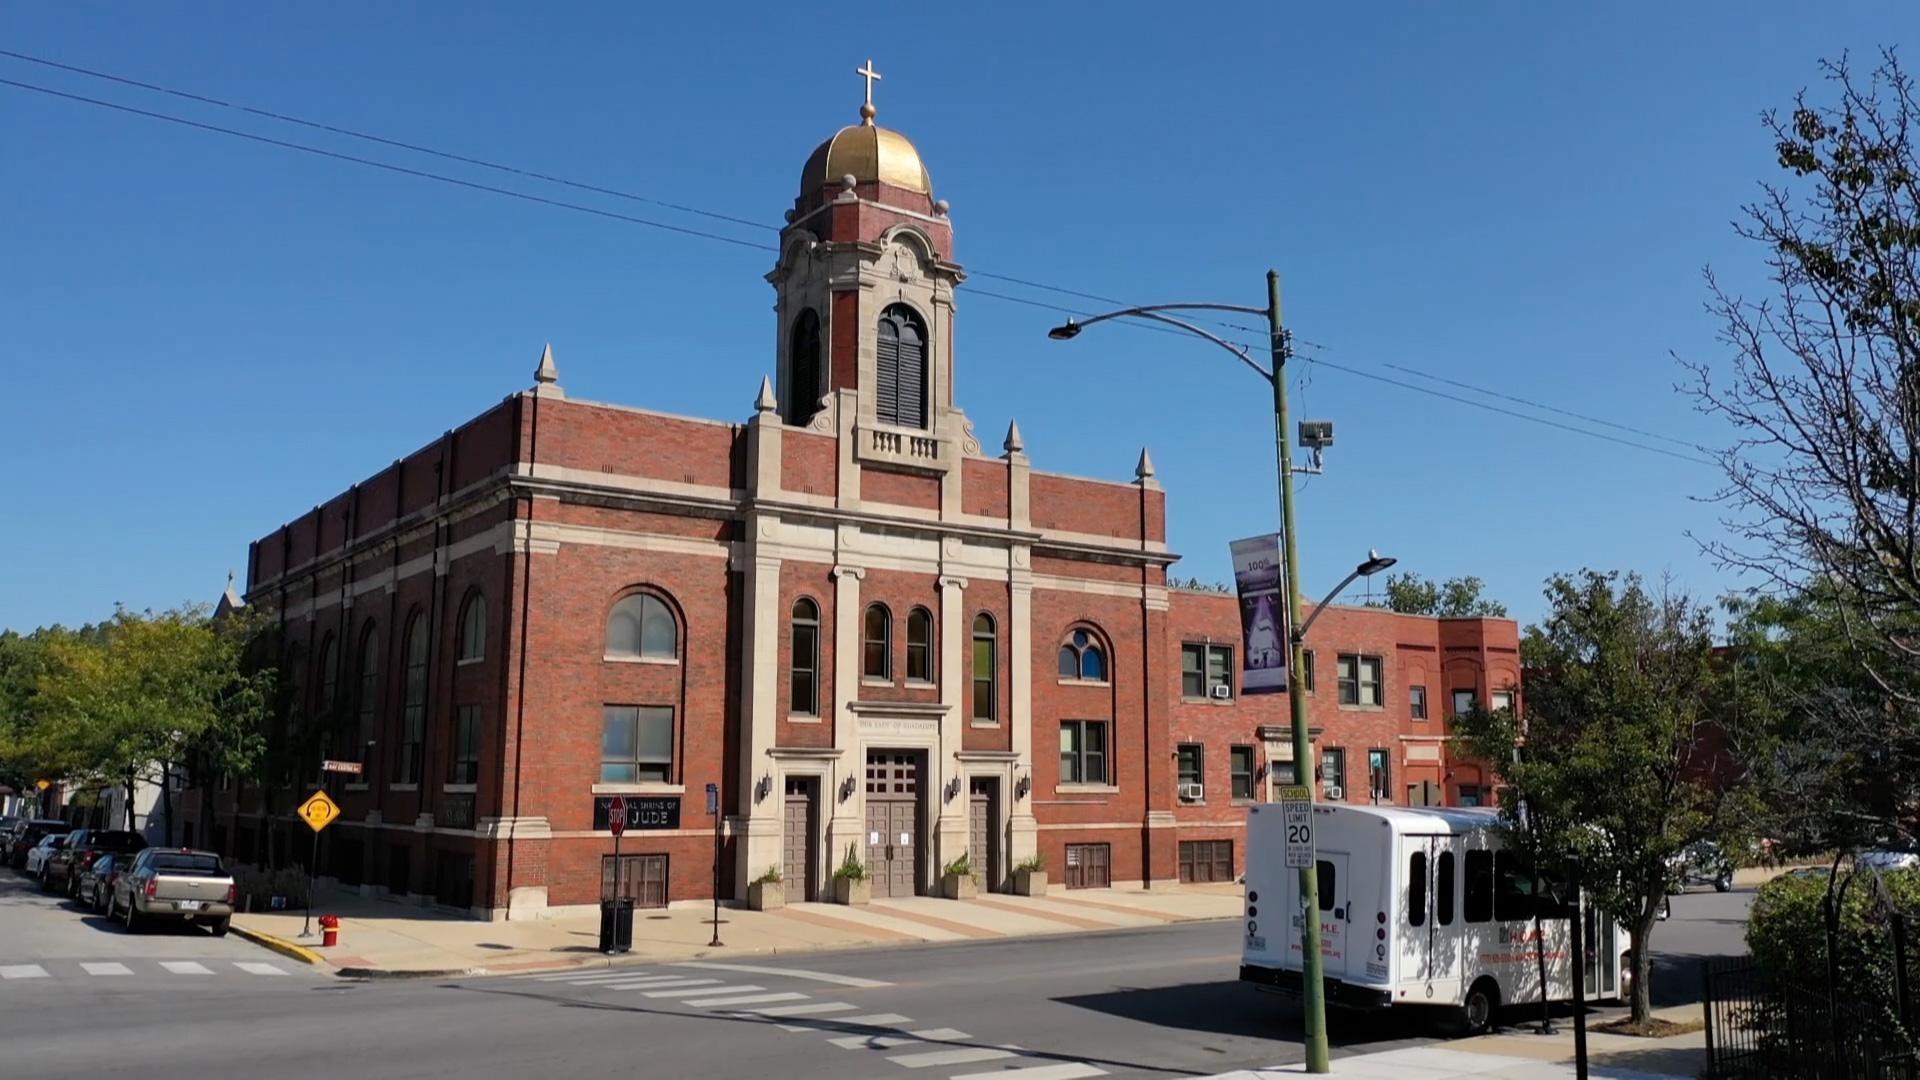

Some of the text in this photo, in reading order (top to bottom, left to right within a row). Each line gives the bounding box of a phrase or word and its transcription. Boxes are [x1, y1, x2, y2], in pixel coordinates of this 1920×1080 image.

[1283, 789, 1307, 798] SCHOOL
[1285, 803, 1309, 812] SPEED
[609, 809, 624, 824] STOP
[631, 811, 668, 824] JUDE
[1288, 814, 1307, 823] LIMIT
[1288, 825, 1310, 843] 20
